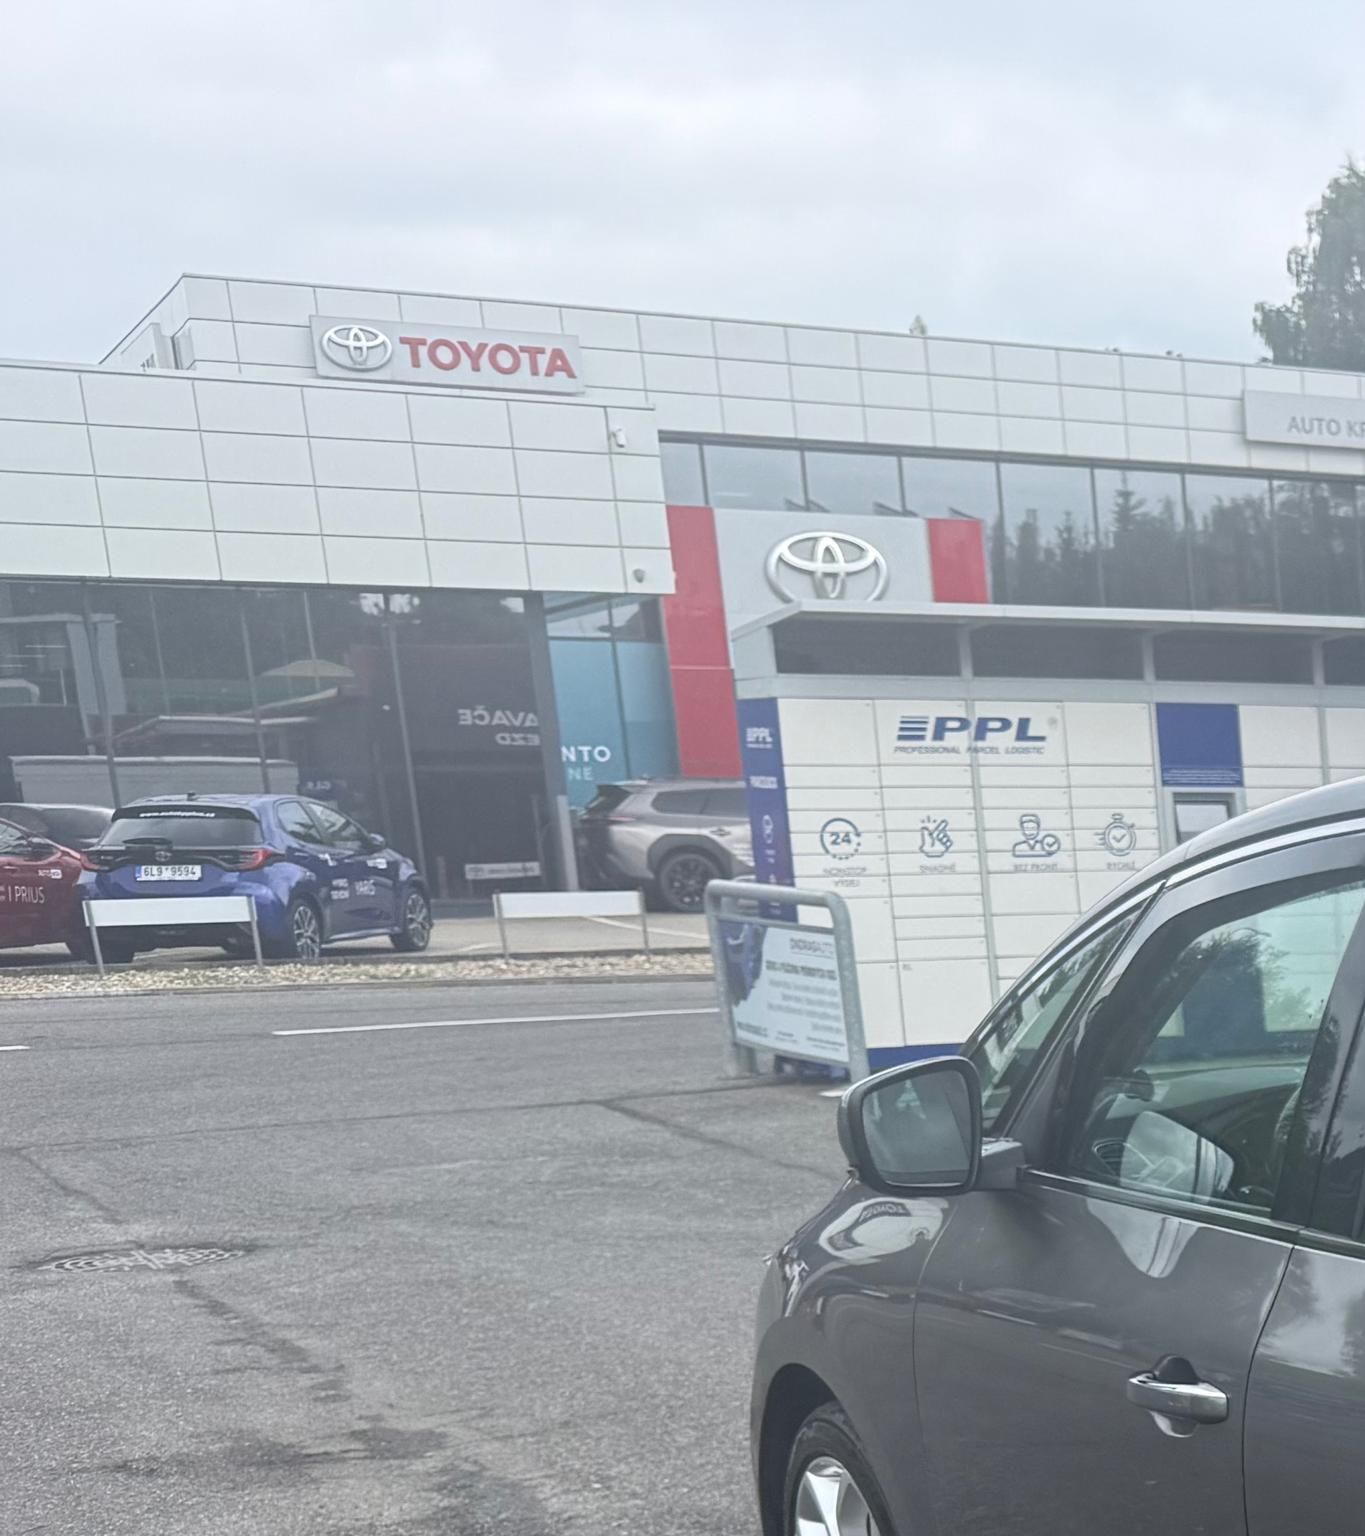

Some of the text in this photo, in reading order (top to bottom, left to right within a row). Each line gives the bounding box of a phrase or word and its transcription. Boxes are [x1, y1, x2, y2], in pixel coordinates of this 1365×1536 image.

[400, 336, 577, 379] TOYOTA
[1288, 416, 1341, 436] AUTO
[931, 717, 1047, 742] PPL
[894, 746, 961, 754] PROFESSIONAL
[830, 832, 852, 846] 24
[14, 885, 46, 904] PRIUS
